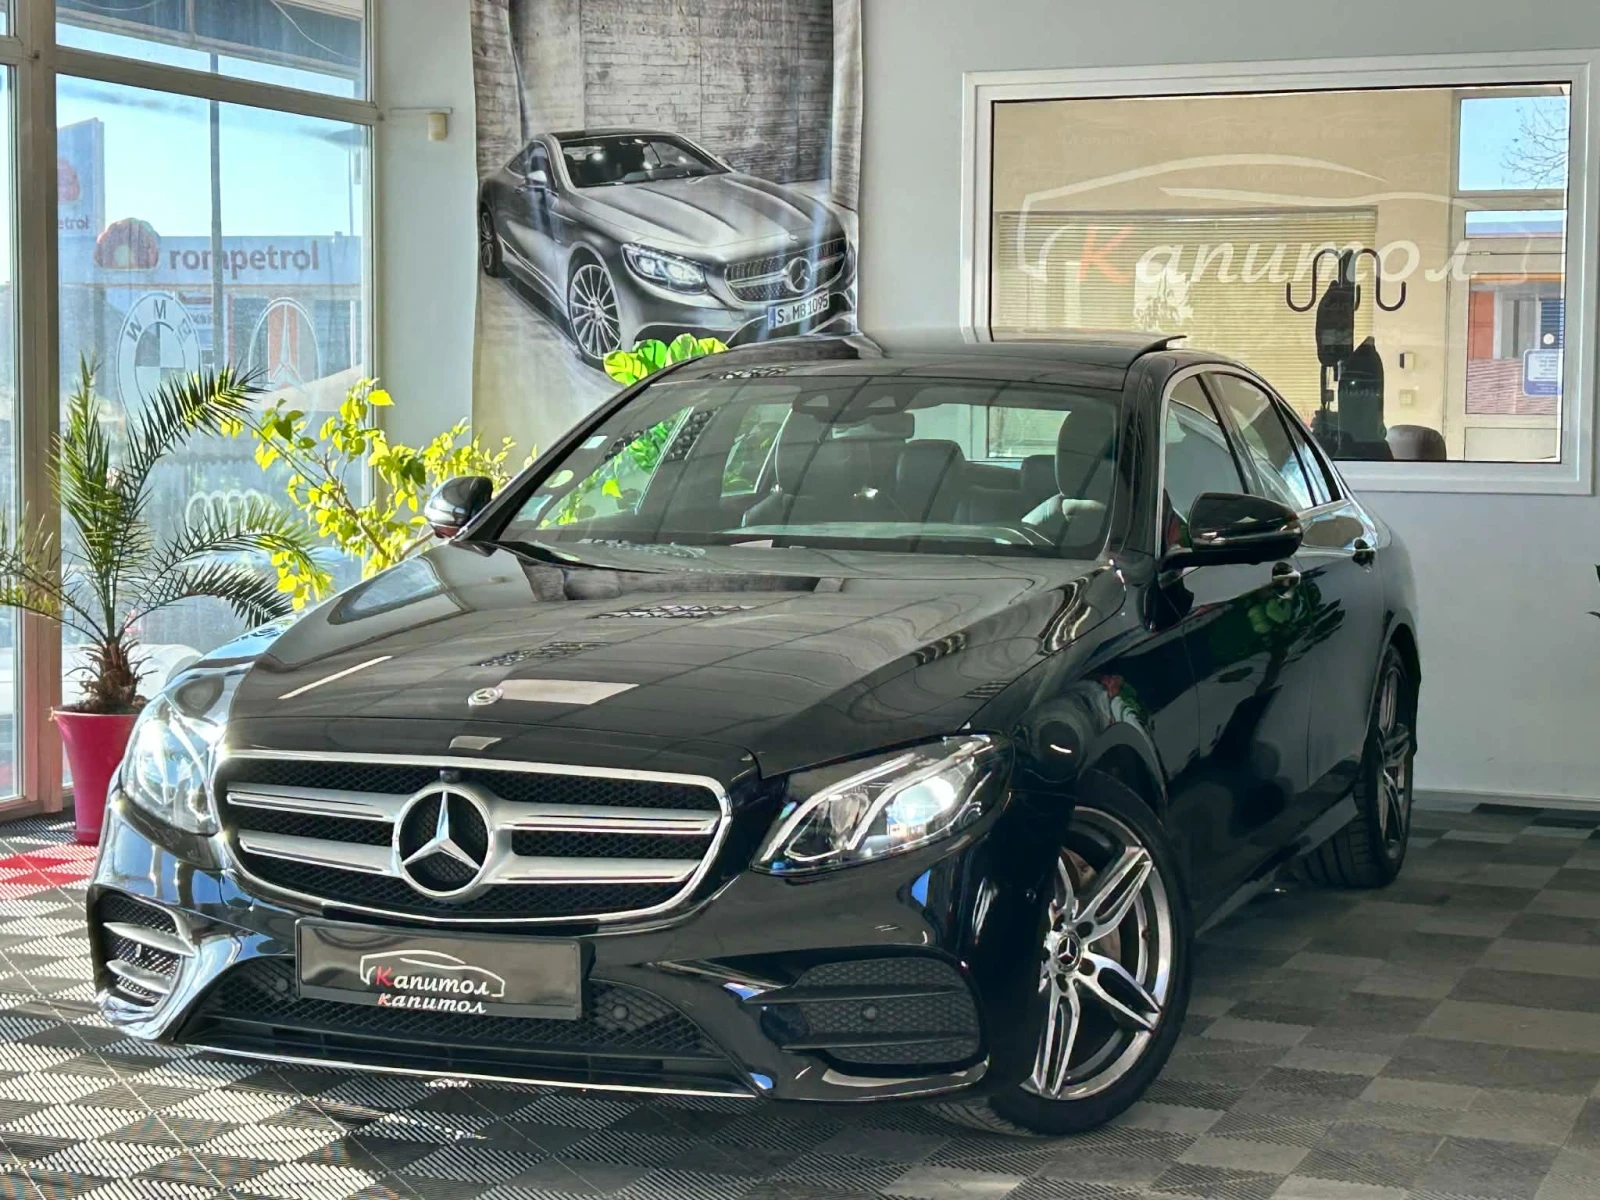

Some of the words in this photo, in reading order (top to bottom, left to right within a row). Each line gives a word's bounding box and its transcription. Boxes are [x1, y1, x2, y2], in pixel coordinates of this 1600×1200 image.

[169, 239, 319, 280] rompetrol
[1077, 226, 1477, 284] Капитол
[777, 308, 785, 324] S
[375, 966, 490, 995] Капитол
